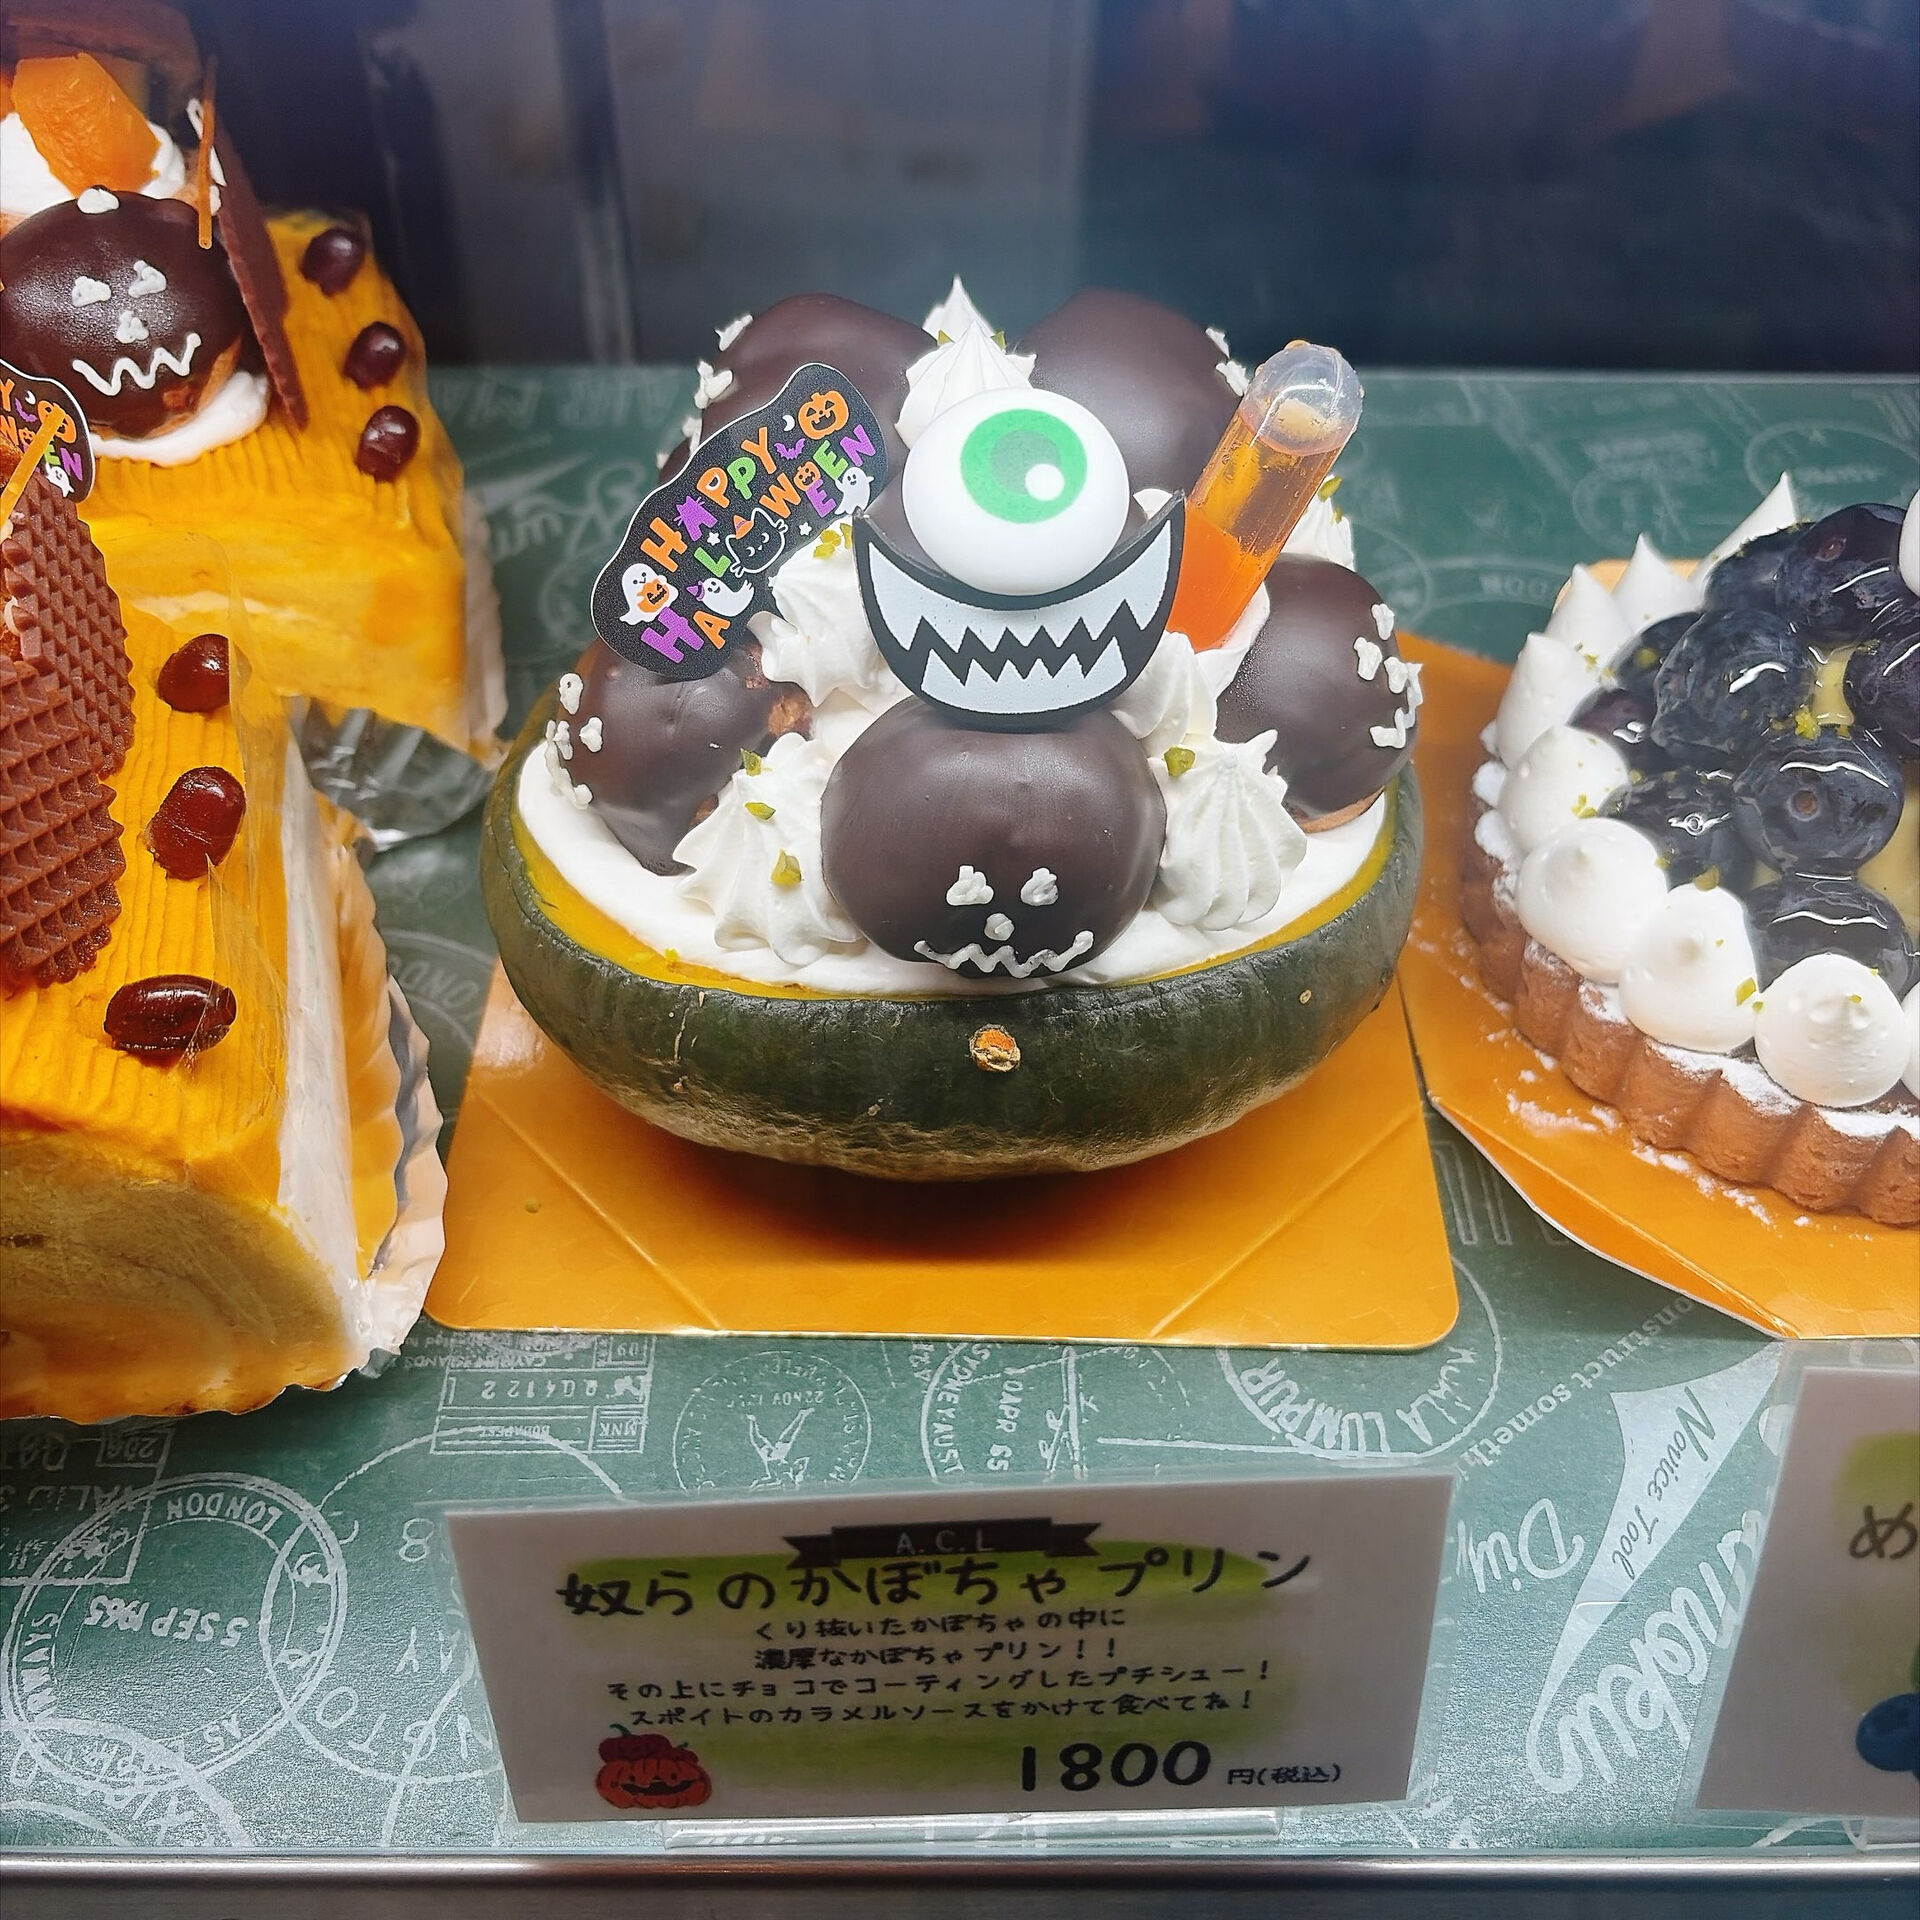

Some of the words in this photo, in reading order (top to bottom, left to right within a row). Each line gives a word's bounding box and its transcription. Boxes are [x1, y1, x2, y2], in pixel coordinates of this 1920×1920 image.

[640, 427, 777, 572] HAPPY
[1571, 1296, 1693, 1390] onstruct
[1238, 1357, 1391, 1457] LUMPUR
[1459, 1384, 1572, 1467] someth
[1647, 1387, 1716, 1501] Novice
[166, 1490, 282, 1536] LONDON
[1611, 1503, 1658, 1580] Tool
[555, 1546, 1311, 1617] 奴らのかぼちゃプリン
[754, 1637, 1116, 1671] 濃厚なかぼちゃプリン！！
[755, 1607, 1126, 1641] くり抜いたかぼちゃの中に
[630, 1689, 1251, 1727] スポイトのカラメルソースをかけて食べてね！
[1021, 1740, 1212, 1792] 1800
[1226, 1762, 1342, 1787] 円(税込)
